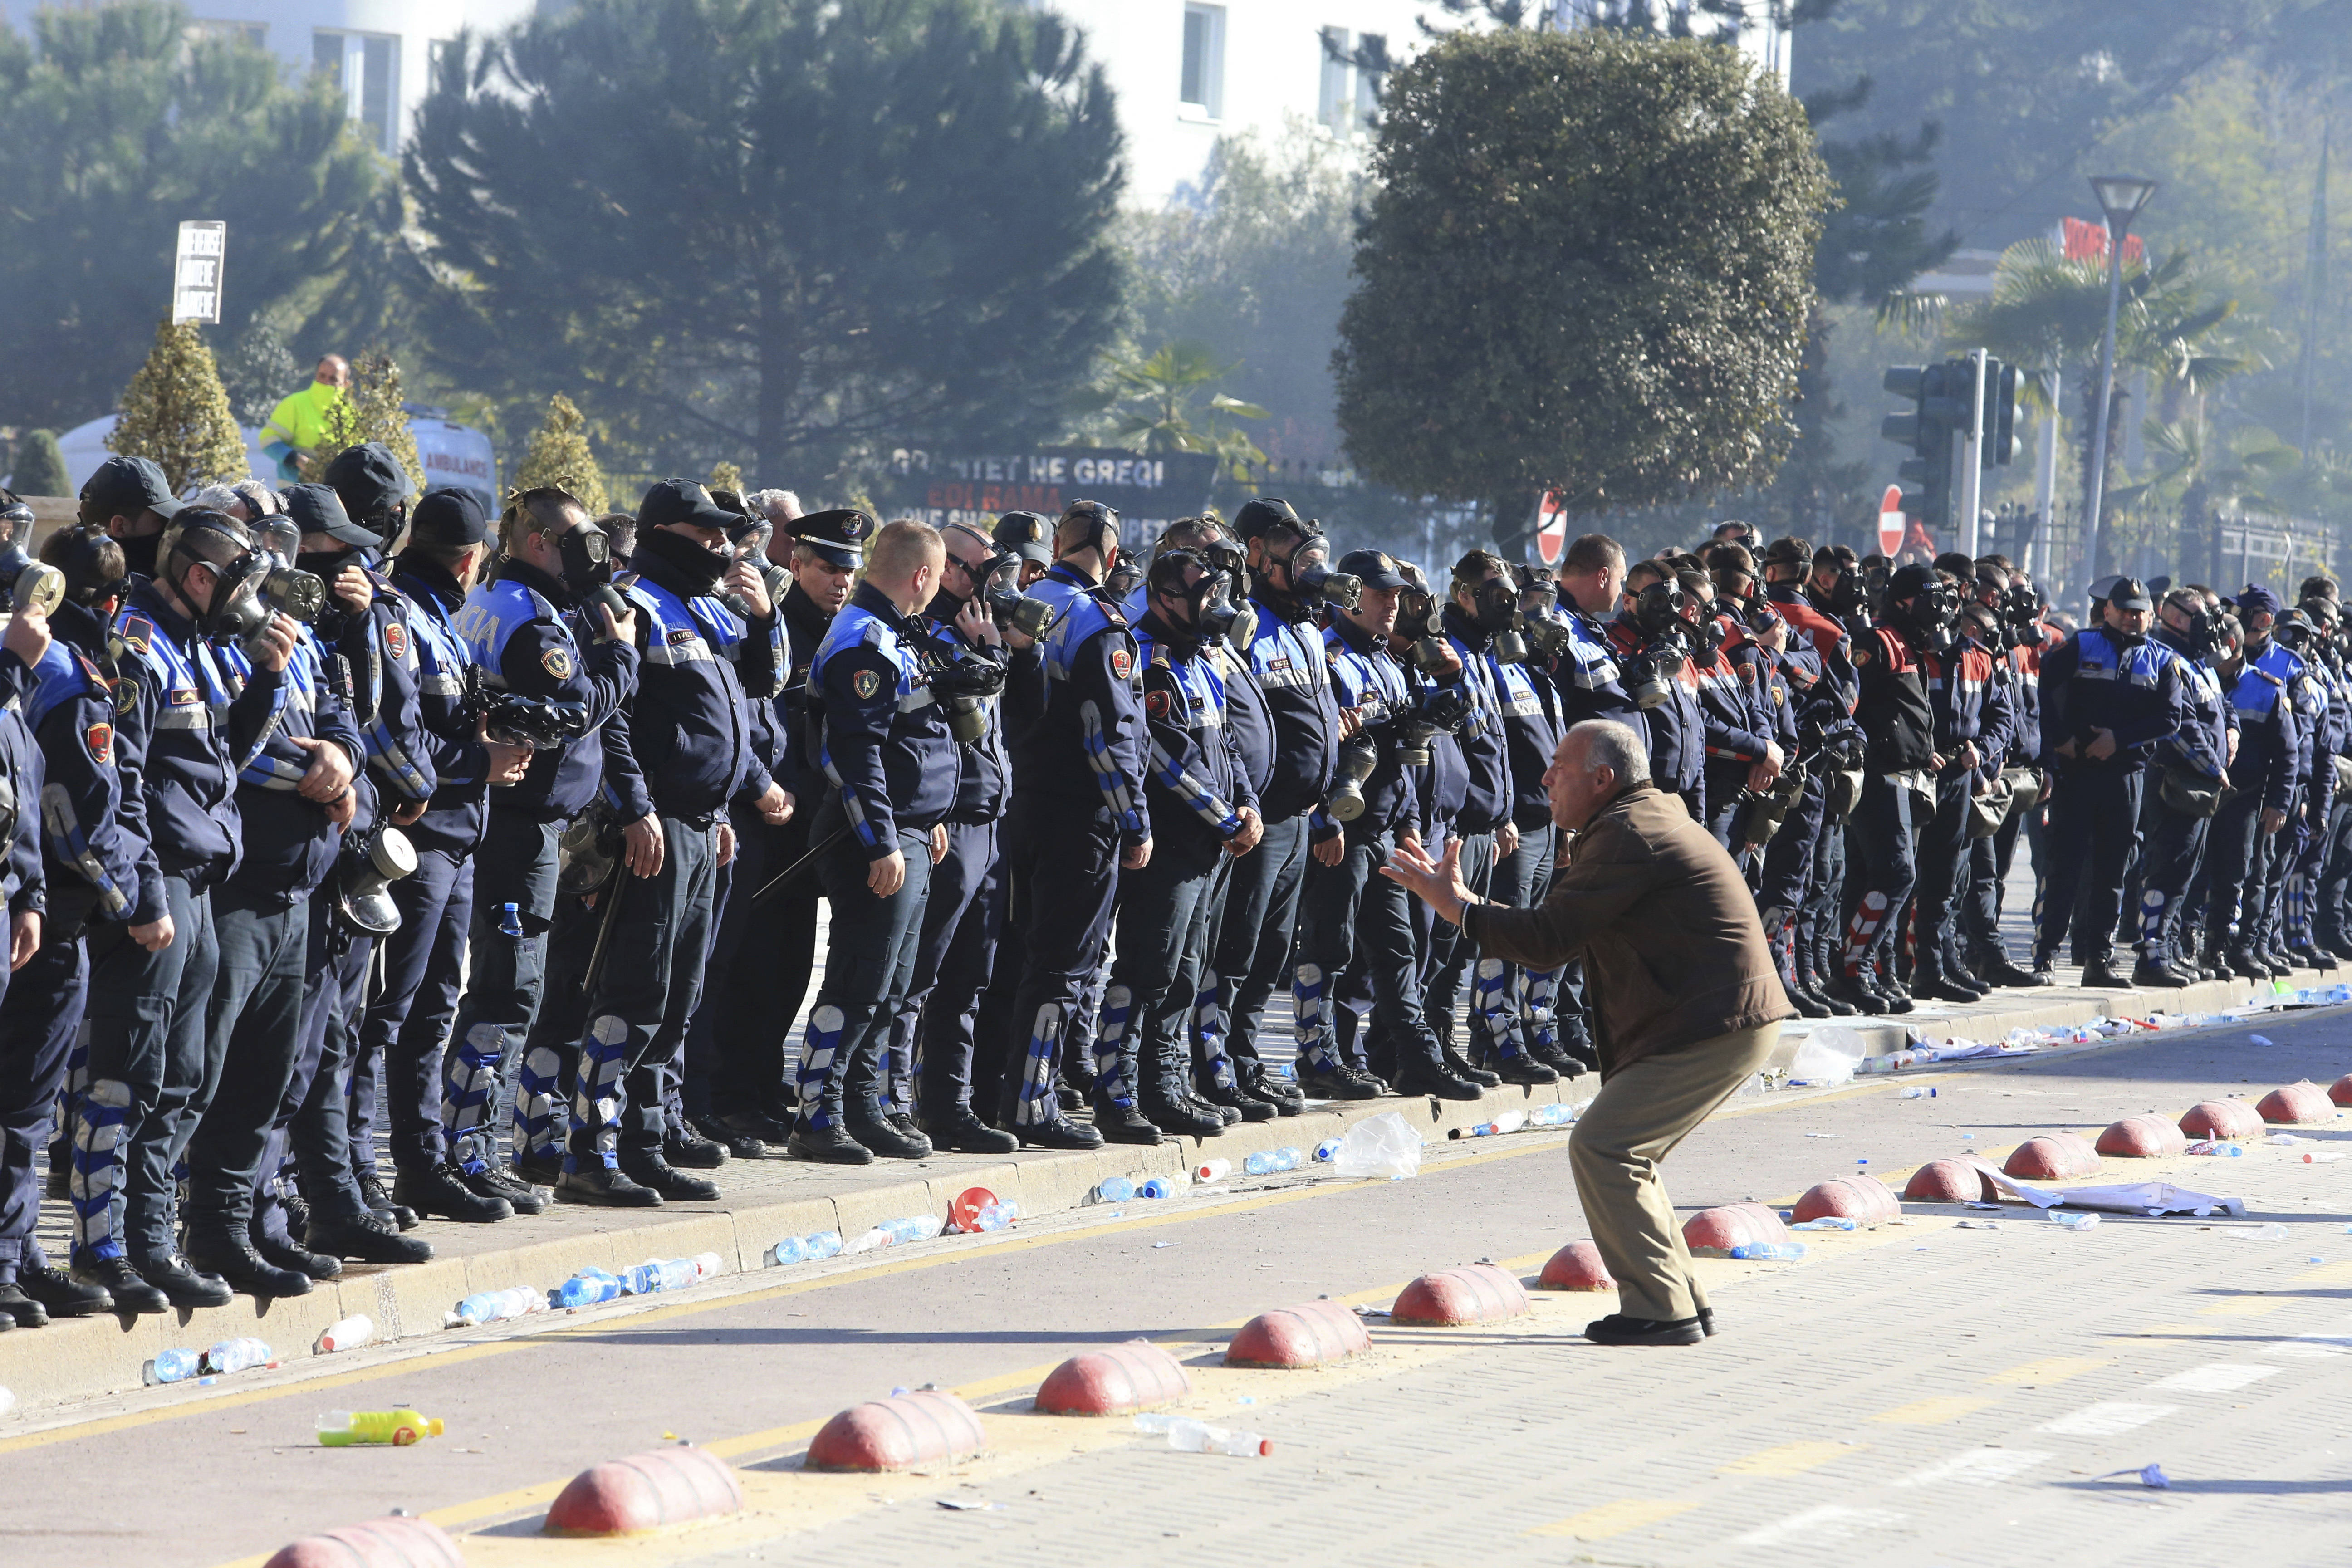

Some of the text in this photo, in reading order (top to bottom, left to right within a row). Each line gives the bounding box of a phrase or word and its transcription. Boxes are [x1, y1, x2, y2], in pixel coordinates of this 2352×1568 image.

[426, 453, 488, 479] AMBULANCE
[1073, 457, 1164, 488] GREQI
[982, 485, 1064, 513] RAMA
